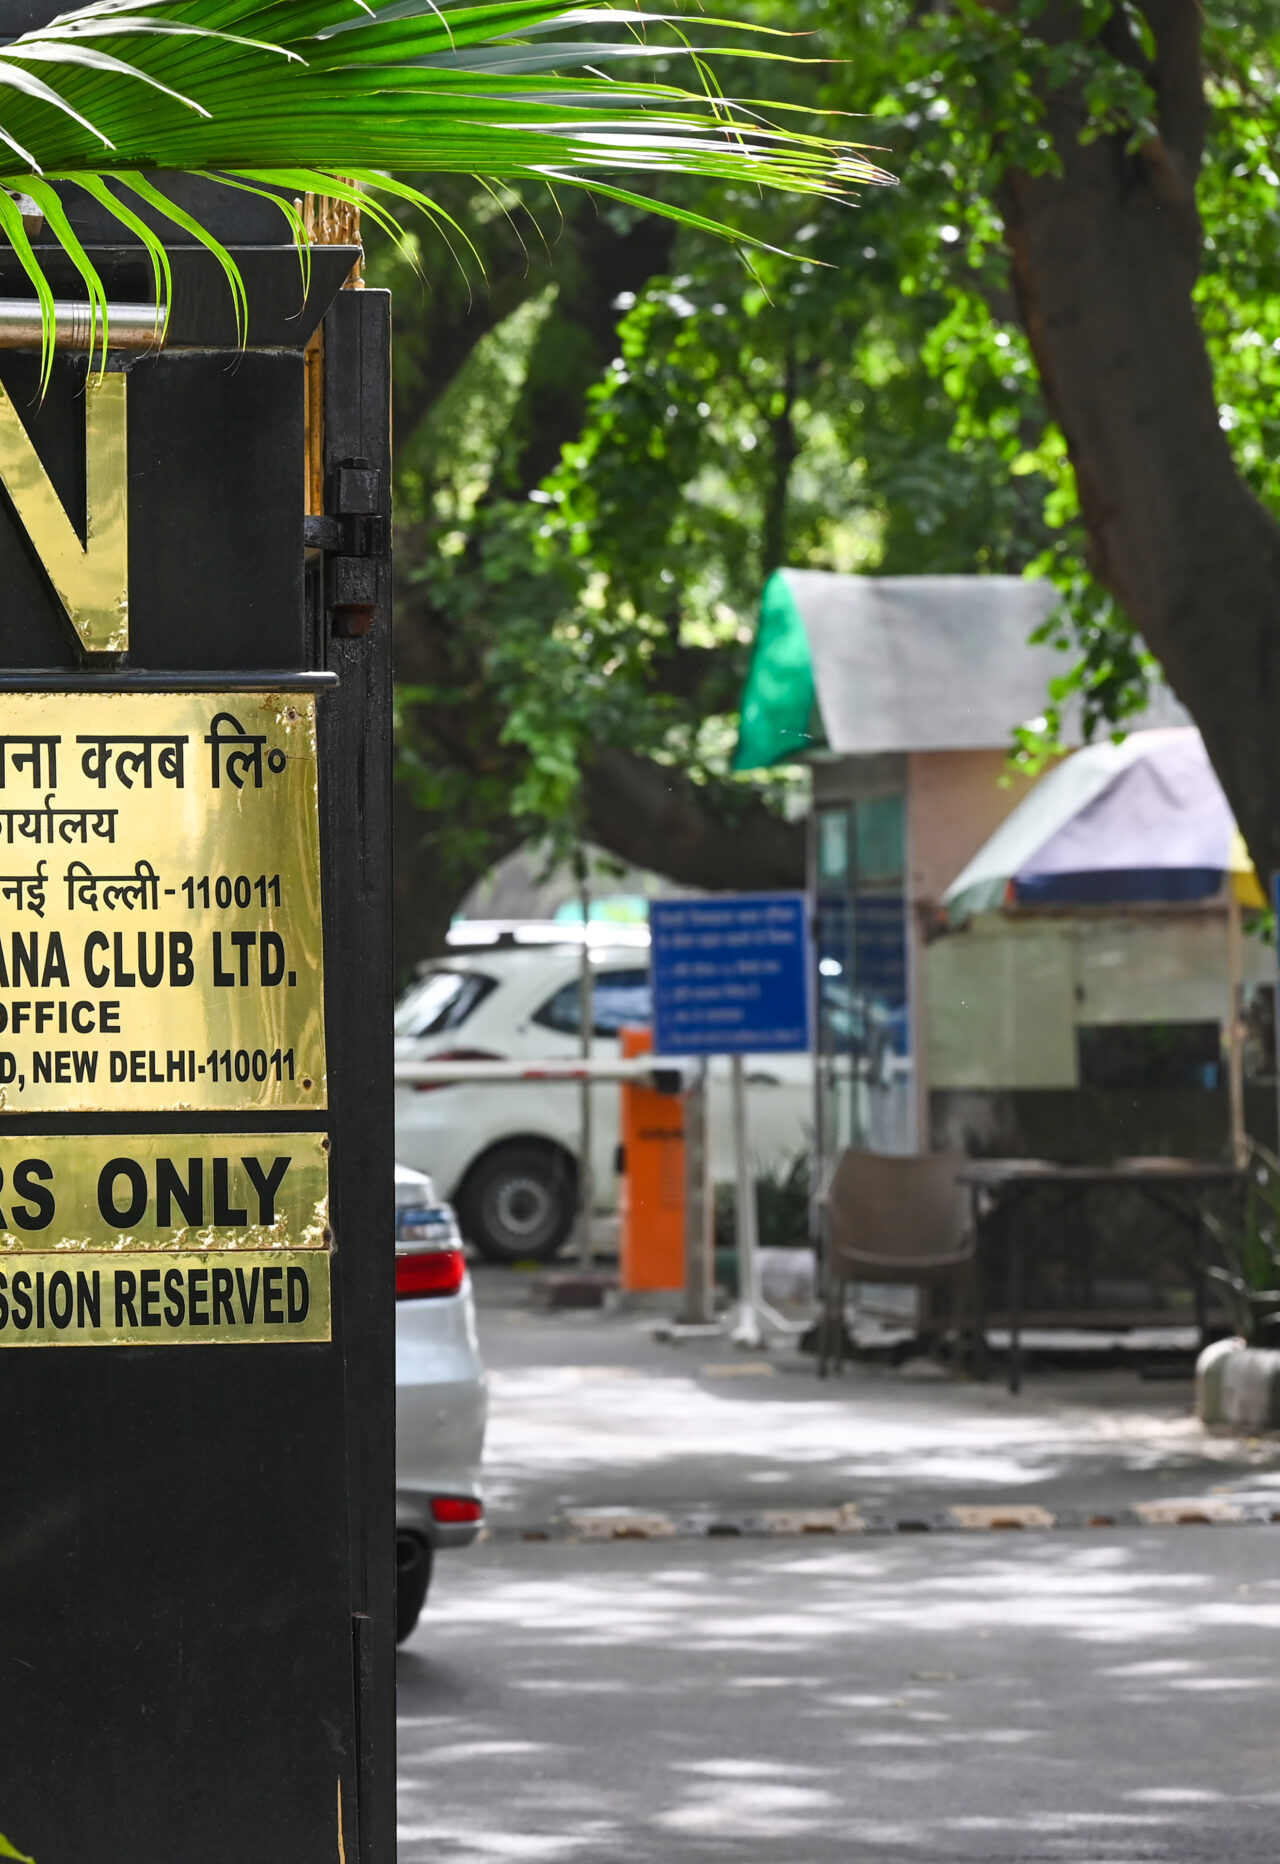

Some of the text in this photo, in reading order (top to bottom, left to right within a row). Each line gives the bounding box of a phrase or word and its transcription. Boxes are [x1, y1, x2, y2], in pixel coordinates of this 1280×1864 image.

[76, 735, 186, 789] क्लब
[84, 930, 195, 989] CLUB
[212, 931, 297, 987] LTD.
[97, 1156, 292, 1229] ONLY
[117, 1266, 310, 1328] RESERVED
